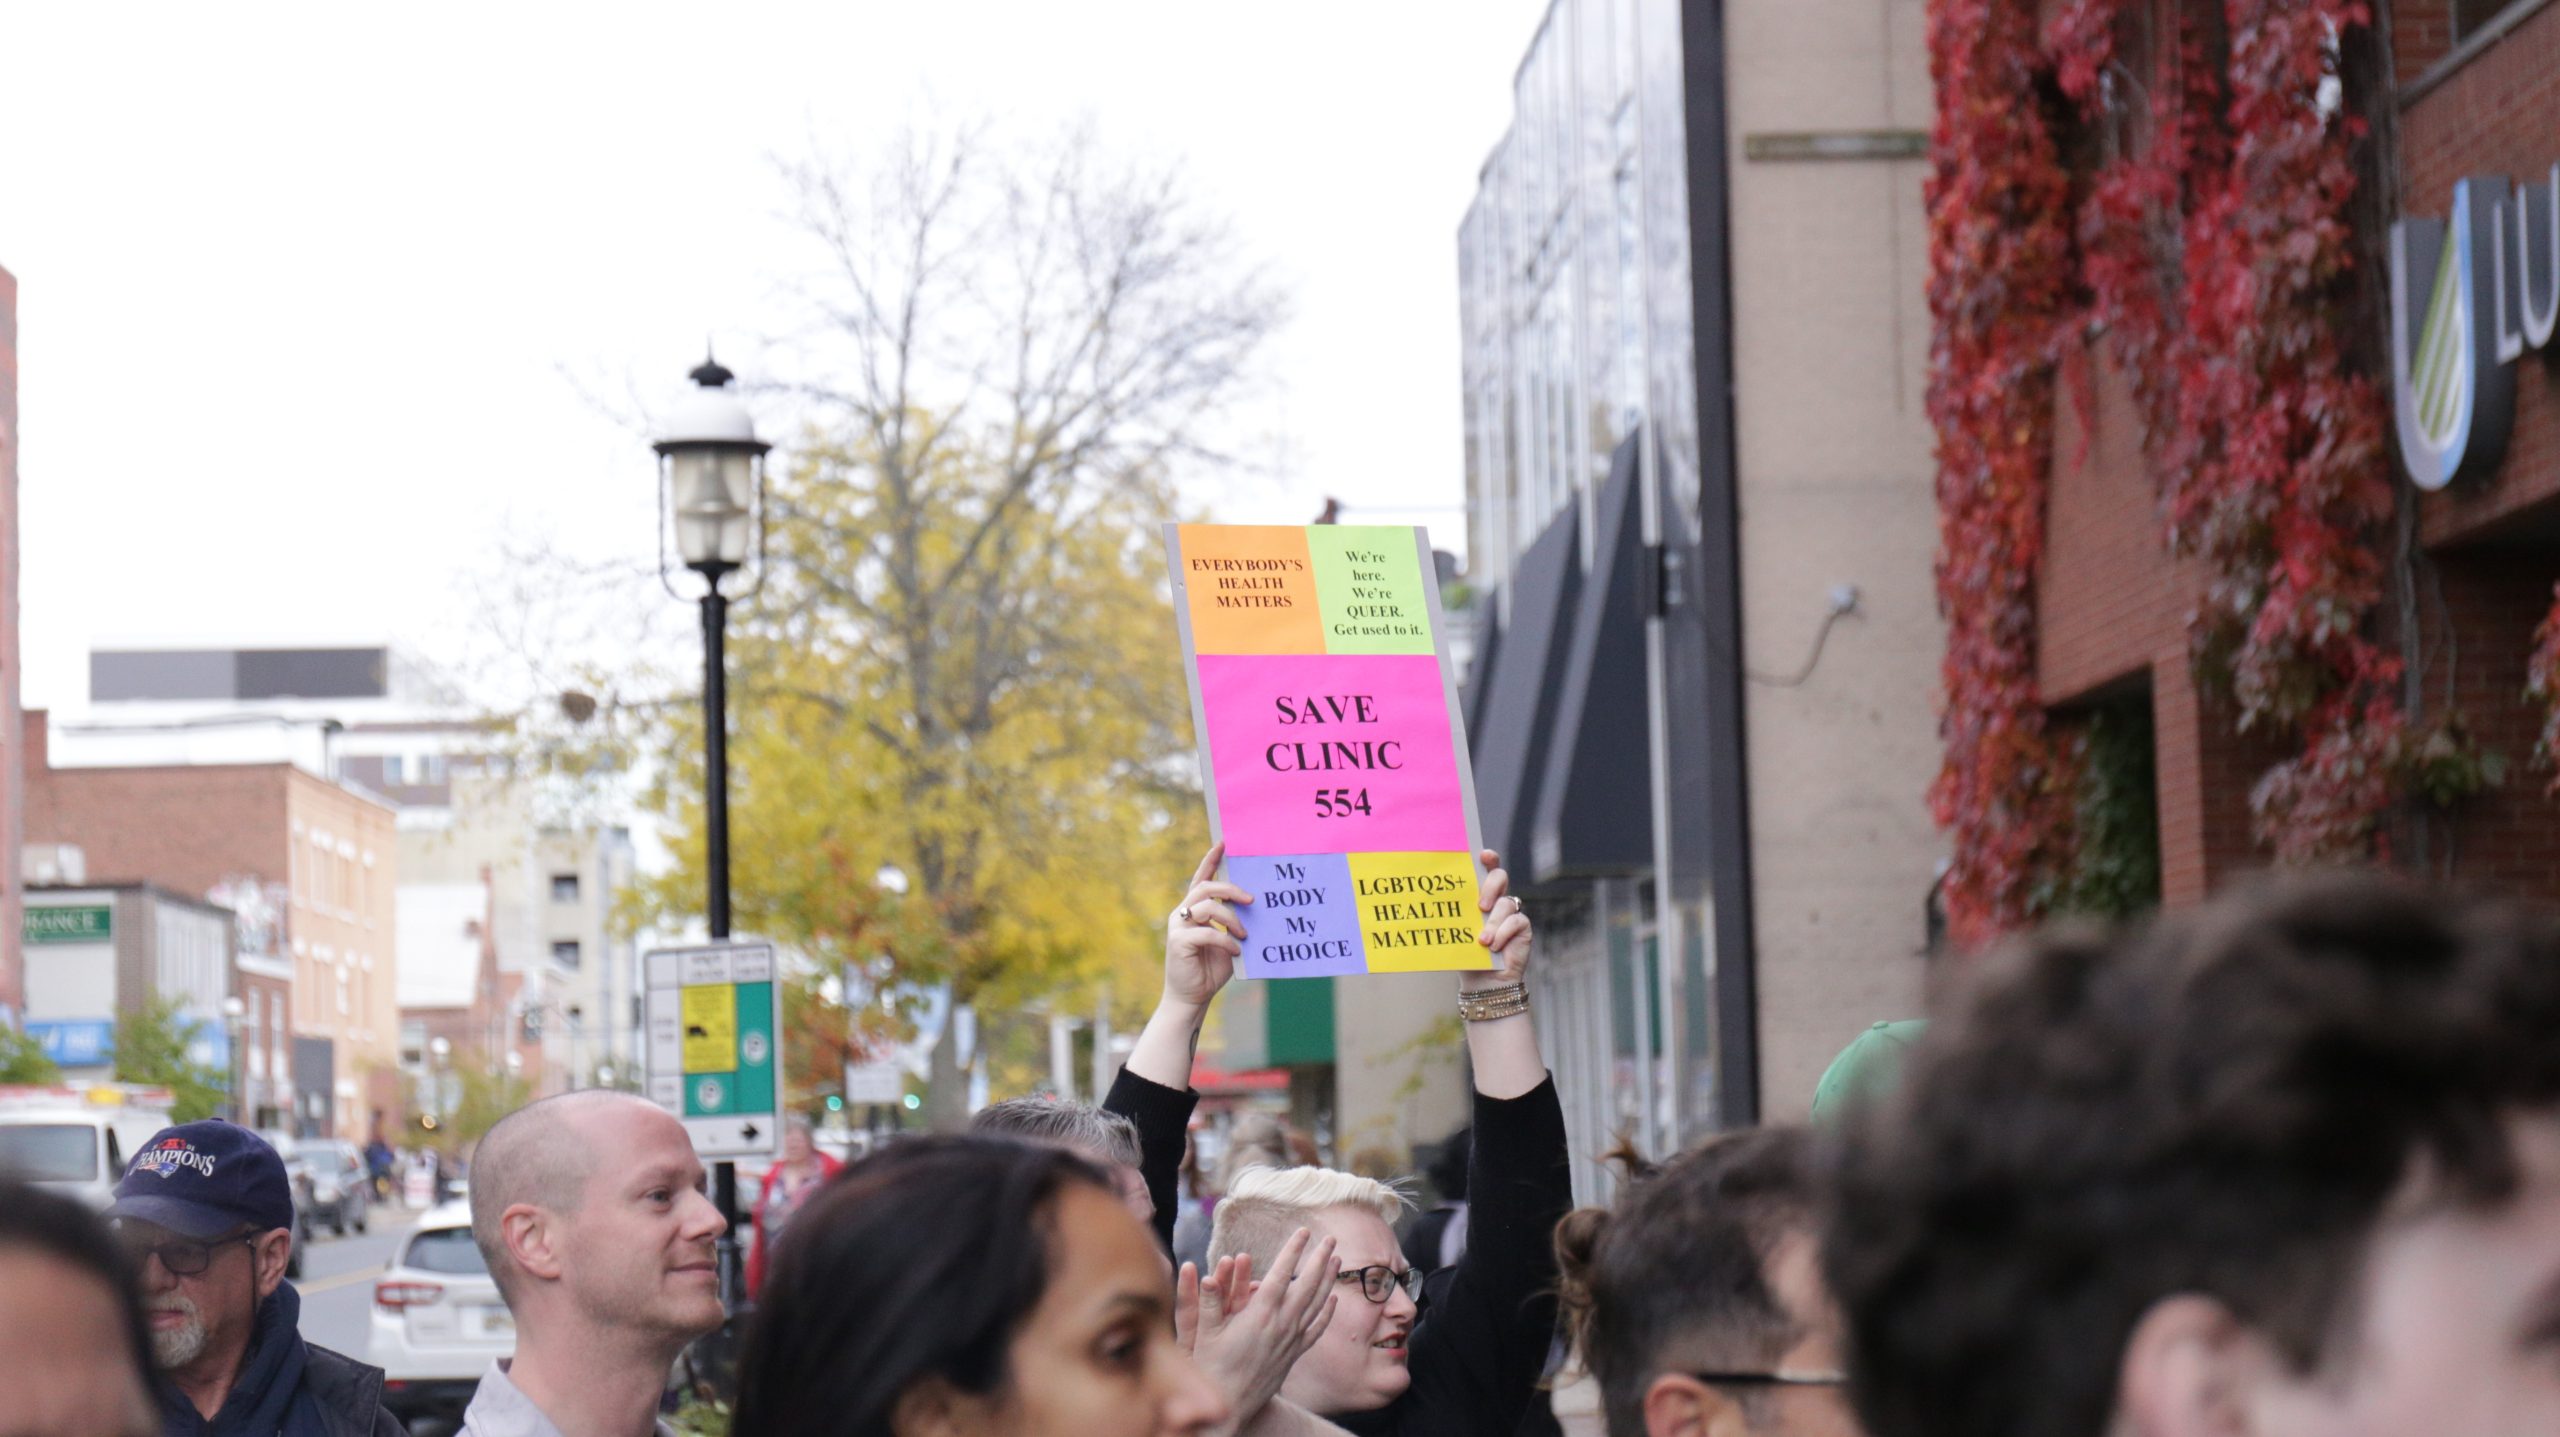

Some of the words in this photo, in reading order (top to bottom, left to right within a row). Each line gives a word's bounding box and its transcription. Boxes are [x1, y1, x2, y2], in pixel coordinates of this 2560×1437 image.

[1191, 558, 1304, 572] EVERYBODY'S
[1345, 551, 1386, 564] We're
[1218, 577, 1284, 590] HEALTH
[1352, 569, 1386, 582] here.
[1216, 596, 1293, 608] MATTERS
[1351, 587, 1393, 600] We're
[1346, 605, 1405, 619] QUEER.
[1334, 624, 1357, 636] Get
[1361, 624, 1390, 636] used
[1393, 625, 1408, 636] to
[1410, 624, 1424, 636] it.
[1275, 695, 1379, 725] SAVE
[1265, 741, 1403, 772] CLINIC
[1314, 787, 1372, 819] 554
[1274, 863, 1306, 882] My
[1358, 874, 1468, 897] LGBTQ2S+
[1264, 888, 1327, 909] BODY
[1373, 901, 1463, 922] HEALTH
[1285, 916, 1317, 938] My
[1372, 927, 1475, 949] MATTERS
[1262, 941, 1353, 964] CHOICE
